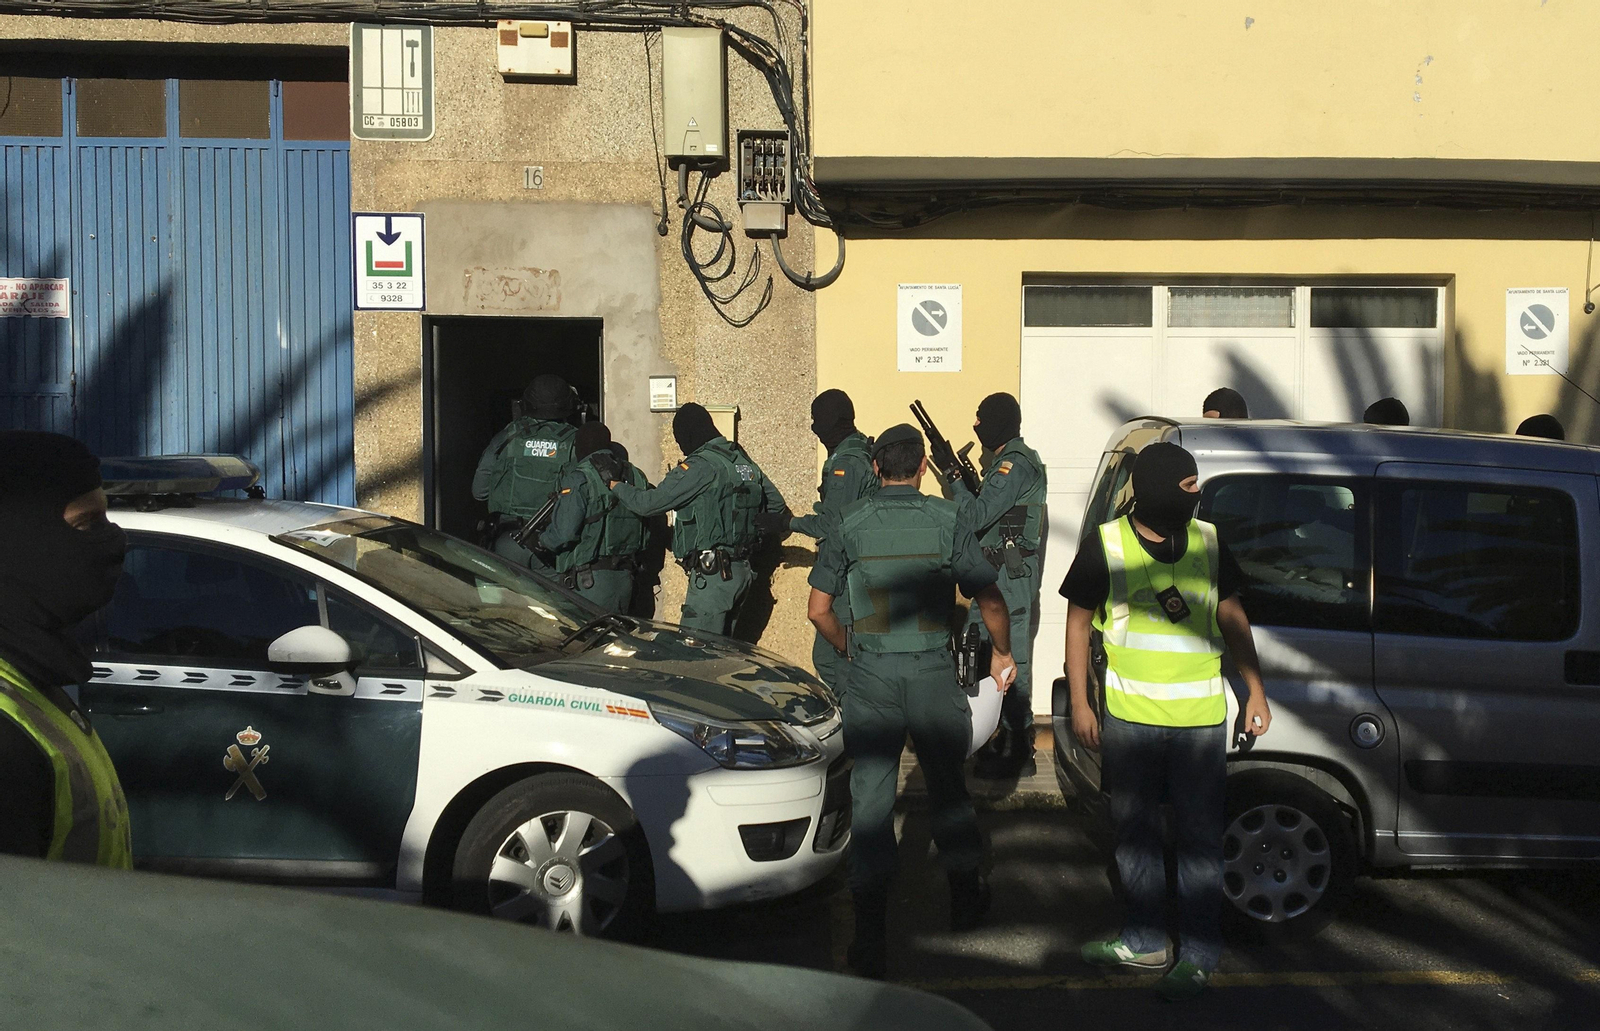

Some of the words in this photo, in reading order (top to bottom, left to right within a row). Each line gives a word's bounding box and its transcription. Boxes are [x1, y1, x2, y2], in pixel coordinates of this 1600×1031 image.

[364, 116, 375, 126] GC
[390, 117, 419, 127] 05803
[525, 168, 543, 186] 16
[29, 283, 64, 291] APARCAR
[380, 294, 403, 302] 9328
[525, 440, 558, 451] GUARDIA
[531, 448, 550, 457] CIVIL
[508, 693, 565, 708] GUARDIA
[570, 700, 603, 713] CIVIL
